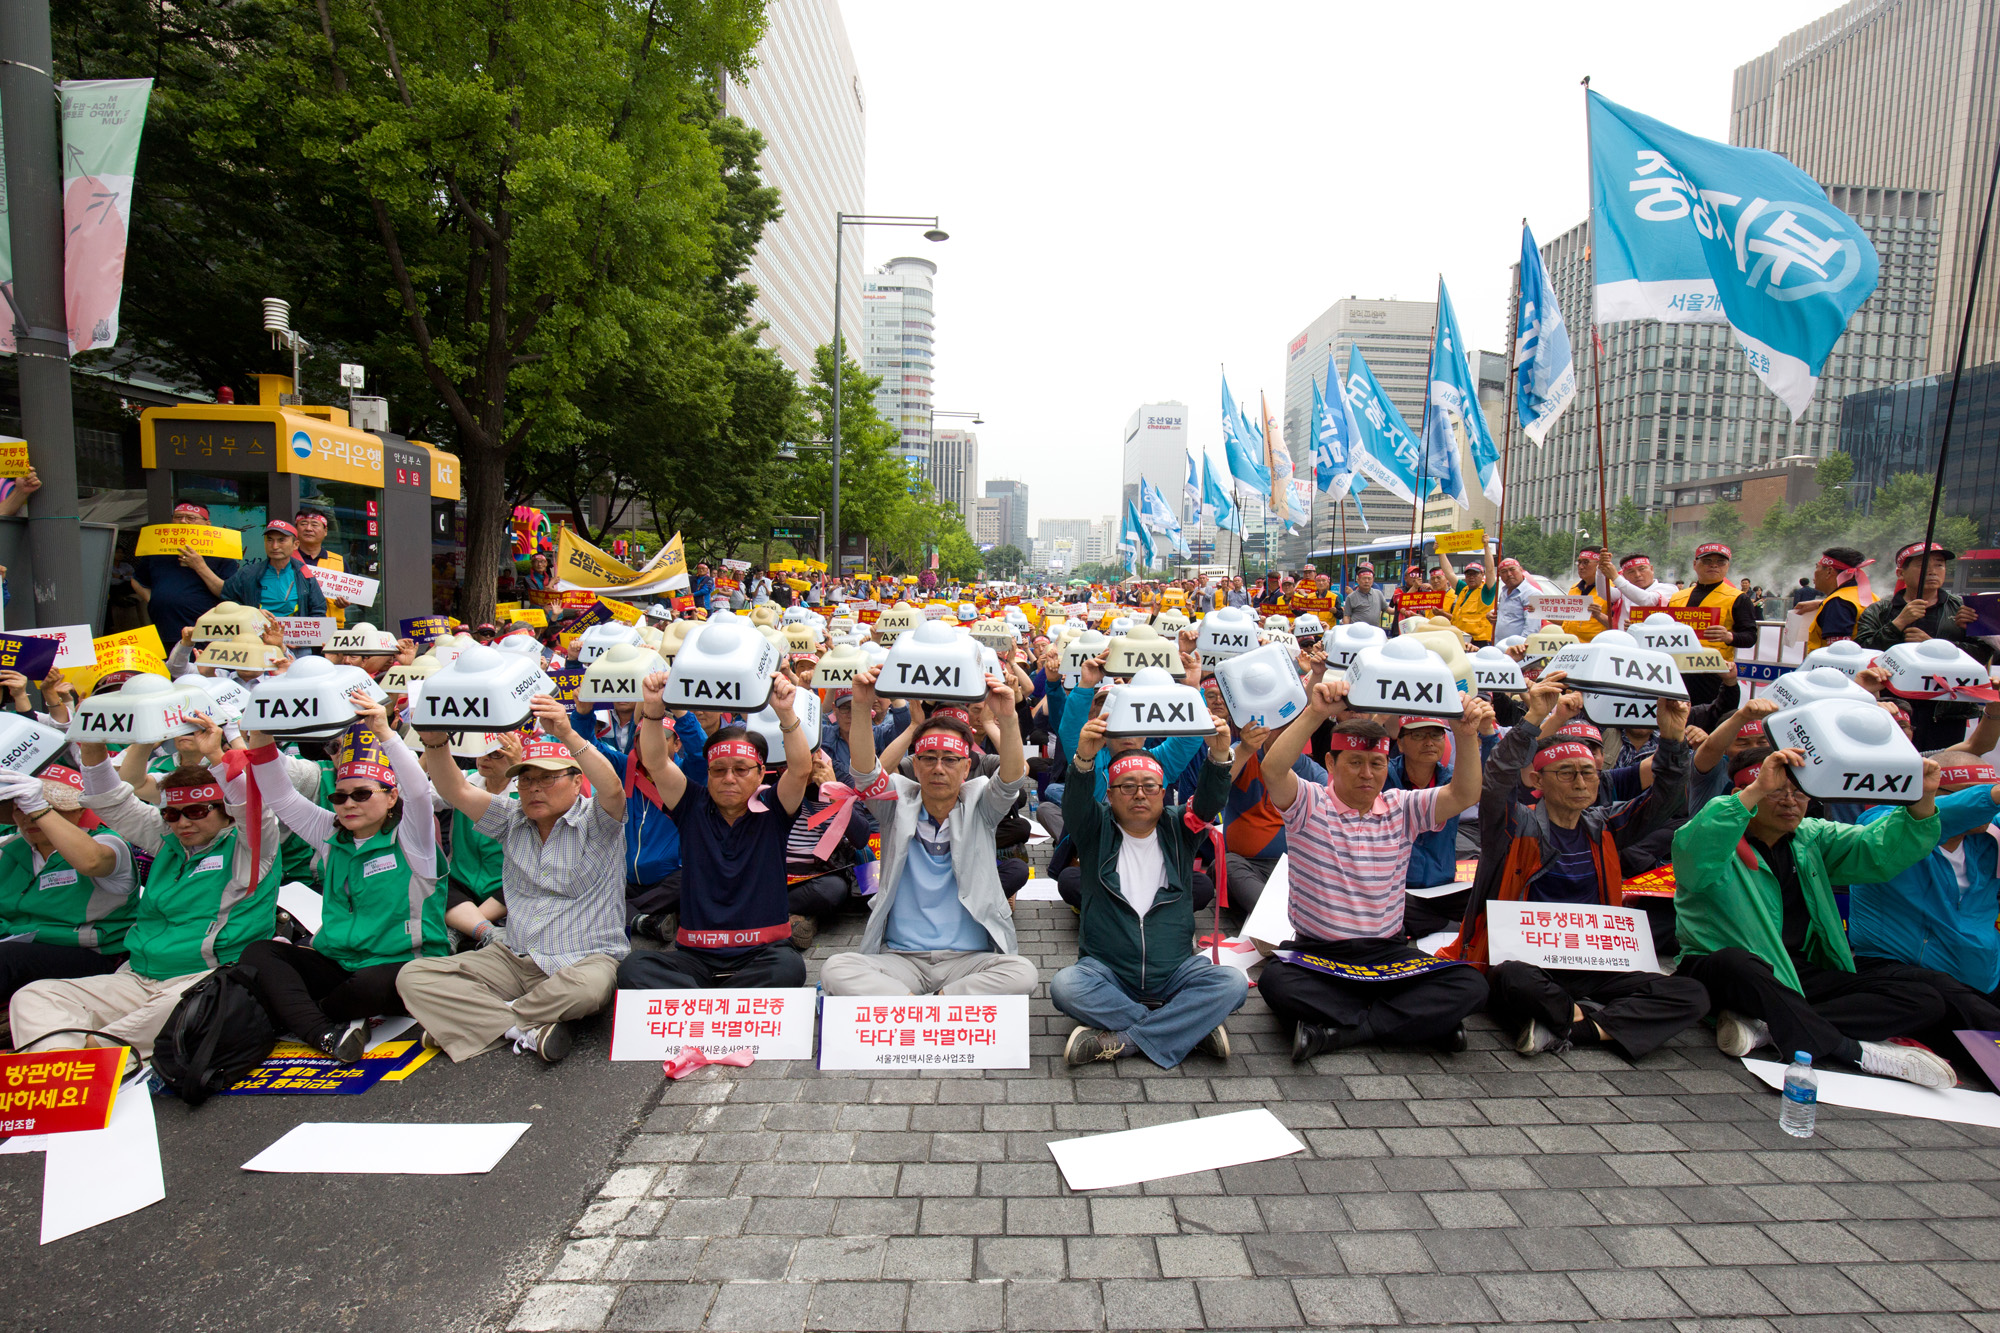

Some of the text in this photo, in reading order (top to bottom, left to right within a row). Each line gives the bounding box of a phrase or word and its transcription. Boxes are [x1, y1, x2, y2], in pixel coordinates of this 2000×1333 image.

[1147, 416, 1182, 425] 조선일보
[170, 434, 265, 456] 안심부스
[316, 437, 382, 471] 우리은행
[393, 452, 422, 466] 안심부스
[437, 463, 453, 484] kt
[154, 528, 199, 536] 대통령까지
[190, 538, 214, 546] OUT!
[1822, 557, 1833, 565] GO
[326, 582, 362, 595] 박멸하라!
[340, 575, 365, 588] 교란종
[883, 618, 909, 627] TAXI
[1674, 611, 1712, 620] 방관하는
[202, 624, 240, 636] TAXI
[978, 624, 1004, 632] TAXI
[118, 634, 139, 648] 속인
[332, 636, 365, 647] TAXI
[790, 640, 808, 649] AXI
[1212, 633, 1248, 647] TAXI
[1267, 633, 1293, 645] TAXI
[1644, 634, 1689, 648] TAXI
[209, 648, 248, 663] TAXI
[1124, 652, 1170, 668] TAXI
[1686, 655, 1720, 667] TAXI
[897, 663, 960, 687] TAXI
[1475, 671, 1515, 684] TAXI
[1610, 656, 1672, 684] TAXI
[591, 678, 635, 693] TAXI
[679, 678, 741, 700] TAXI
[1376, 679, 1443, 703] TAXI
[255, 697, 318, 718] TAXI
[426, 696, 488, 717] TAXI
[1130, 702, 1195, 722] TAXI
[1613, 703, 1657, 718] TAX
[80, 712, 134, 732] TAXI
[956, 711, 968, 722] GO
[529, 745, 554, 757] 결단
[915, 736, 964, 751] 정치적 결단
[1544, 743, 1583, 759] 정치적
[707, 744, 757, 760] 정치적 결단
[1112, 758, 1143, 774] 정치적
[1975, 767, 1998, 780] 결단
[354, 764, 396, 785] 결단 GO
[1842, 773, 1913, 793] TAXI
[190, 787, 214, 799] GO
[1519, 910, 1635, 932] 교통생태계 교란종
[687, 931, 760, 945] 택시규제 OUT
[1521, 931, 1640, 951] ‘타다’를 박멸하라!
[1543, 955, 1630, 967] 서울개인택시운송사업조합
[646, 998, 785, 1016] 교통생태계 교란종
[855, 1005, 998, 1024] 교통생태계 교란종
[646, 1020, 782, 1038] ‘타다’를 박멸하라!
[856, 1028, 996, 1046] ‘타다’를 박멸하라!
[875, 1053, 975, 1064] 서울개인택시운송사업조합
[6, 1061, 96, 1086] 방관하는
